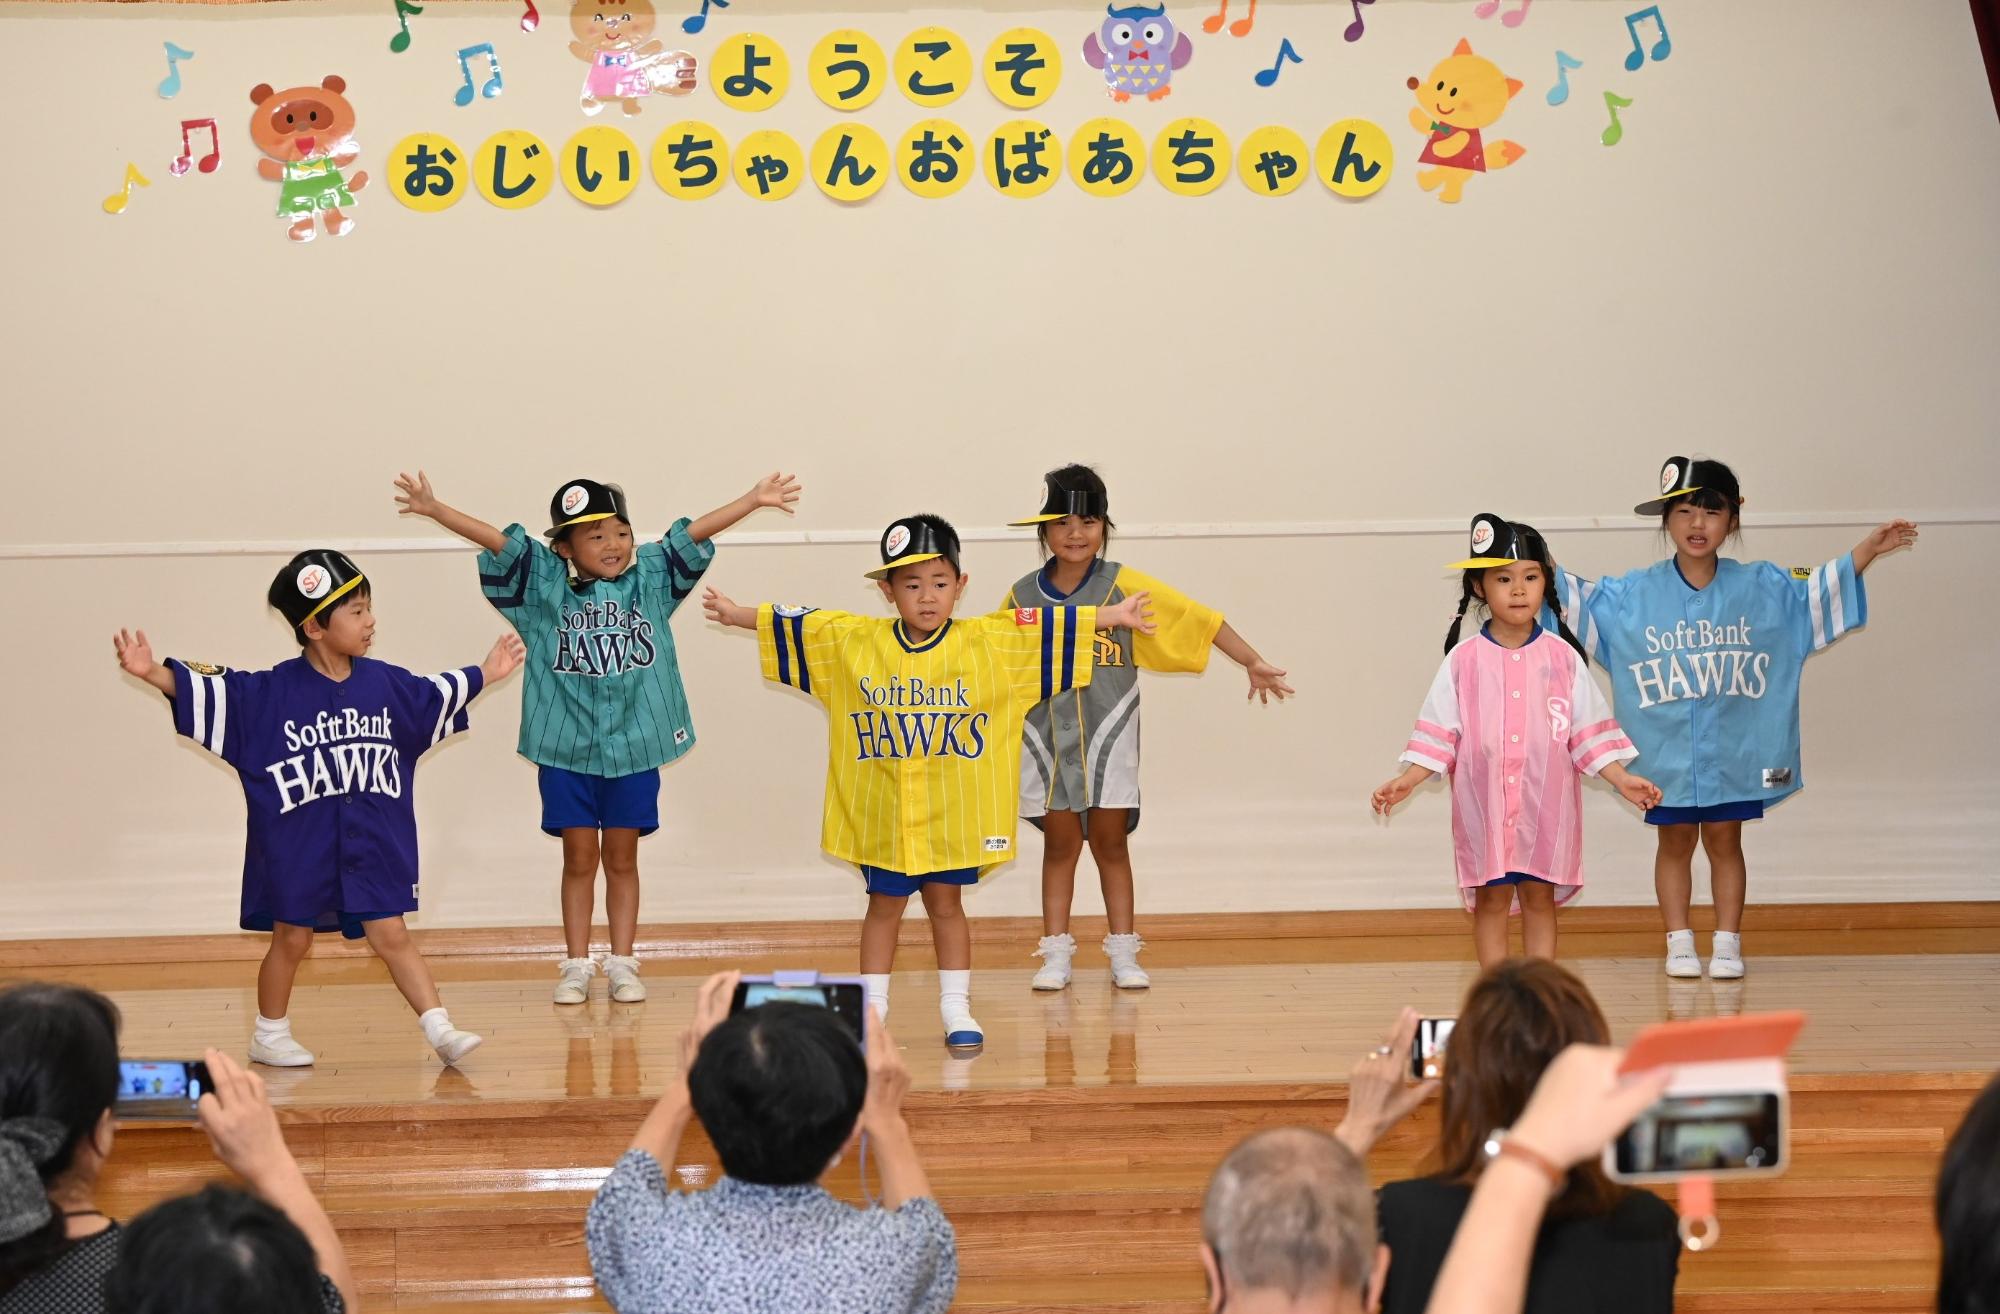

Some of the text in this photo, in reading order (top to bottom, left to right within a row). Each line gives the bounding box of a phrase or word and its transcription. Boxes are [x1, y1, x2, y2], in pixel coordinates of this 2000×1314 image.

[722, 40, 1046, 101] ようこそ
[1645, 616, 1752, 654] SoftBank
[859, 676, 970, 707] SoftBank
[1628, 650, 1770, 709] HAWKS
[283, 706, 392, 752] SoftBank
[849, 710, 989, 760] HAWKS
[265, 742, 402, 814] HAWKS
